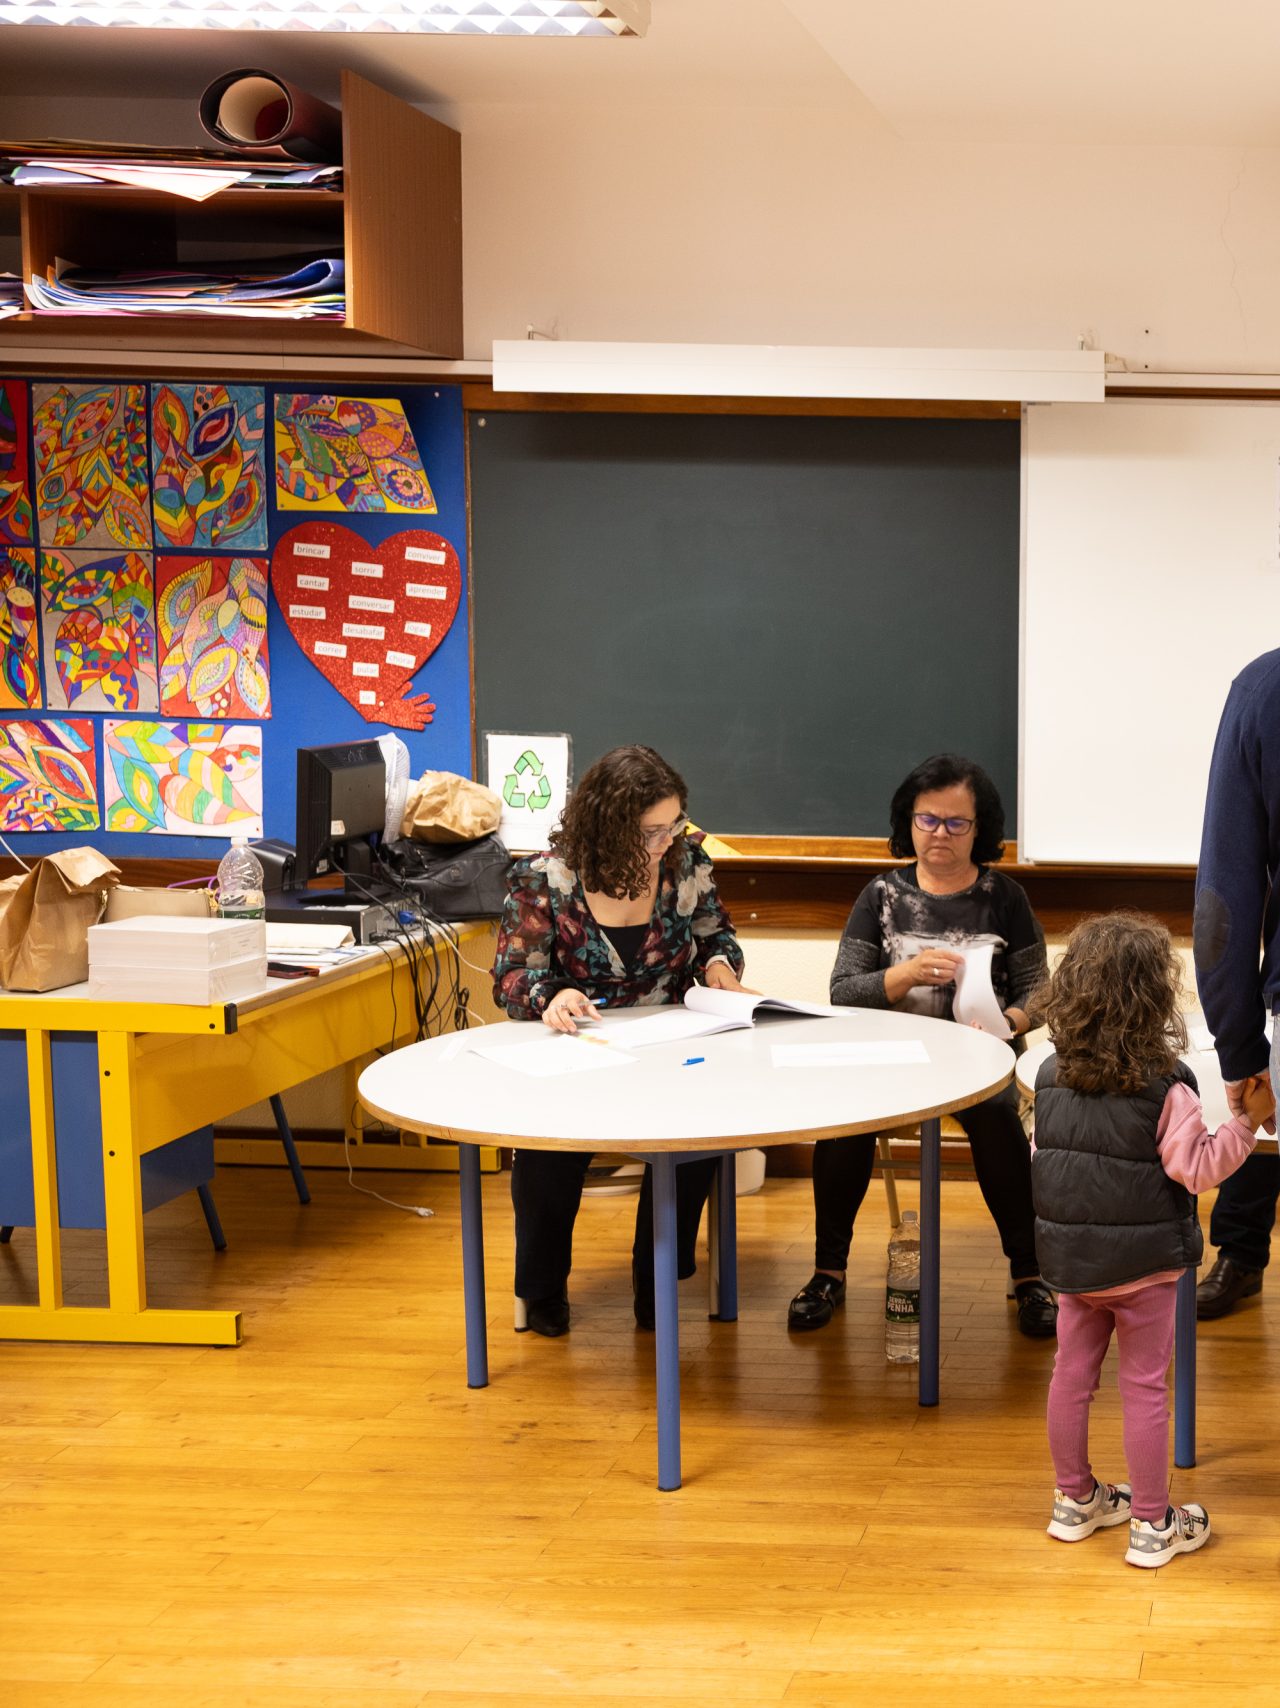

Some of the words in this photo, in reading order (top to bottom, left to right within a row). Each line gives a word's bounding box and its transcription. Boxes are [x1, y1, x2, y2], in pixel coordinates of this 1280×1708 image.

[296, 545, 326, 556] brincar
[407, 550, 441, 561] conviver
[354, 566, 378, 575] sorrir
[299, 577, 327, 588] cantar
[408, 586, 445, 596] aprender
[351, 599, 391, 610] conversar
[291, 607, 323, 618] estudar
[344, 626, 384, 637] desabafar
[887, 1301, 914, 1313] PENHA
